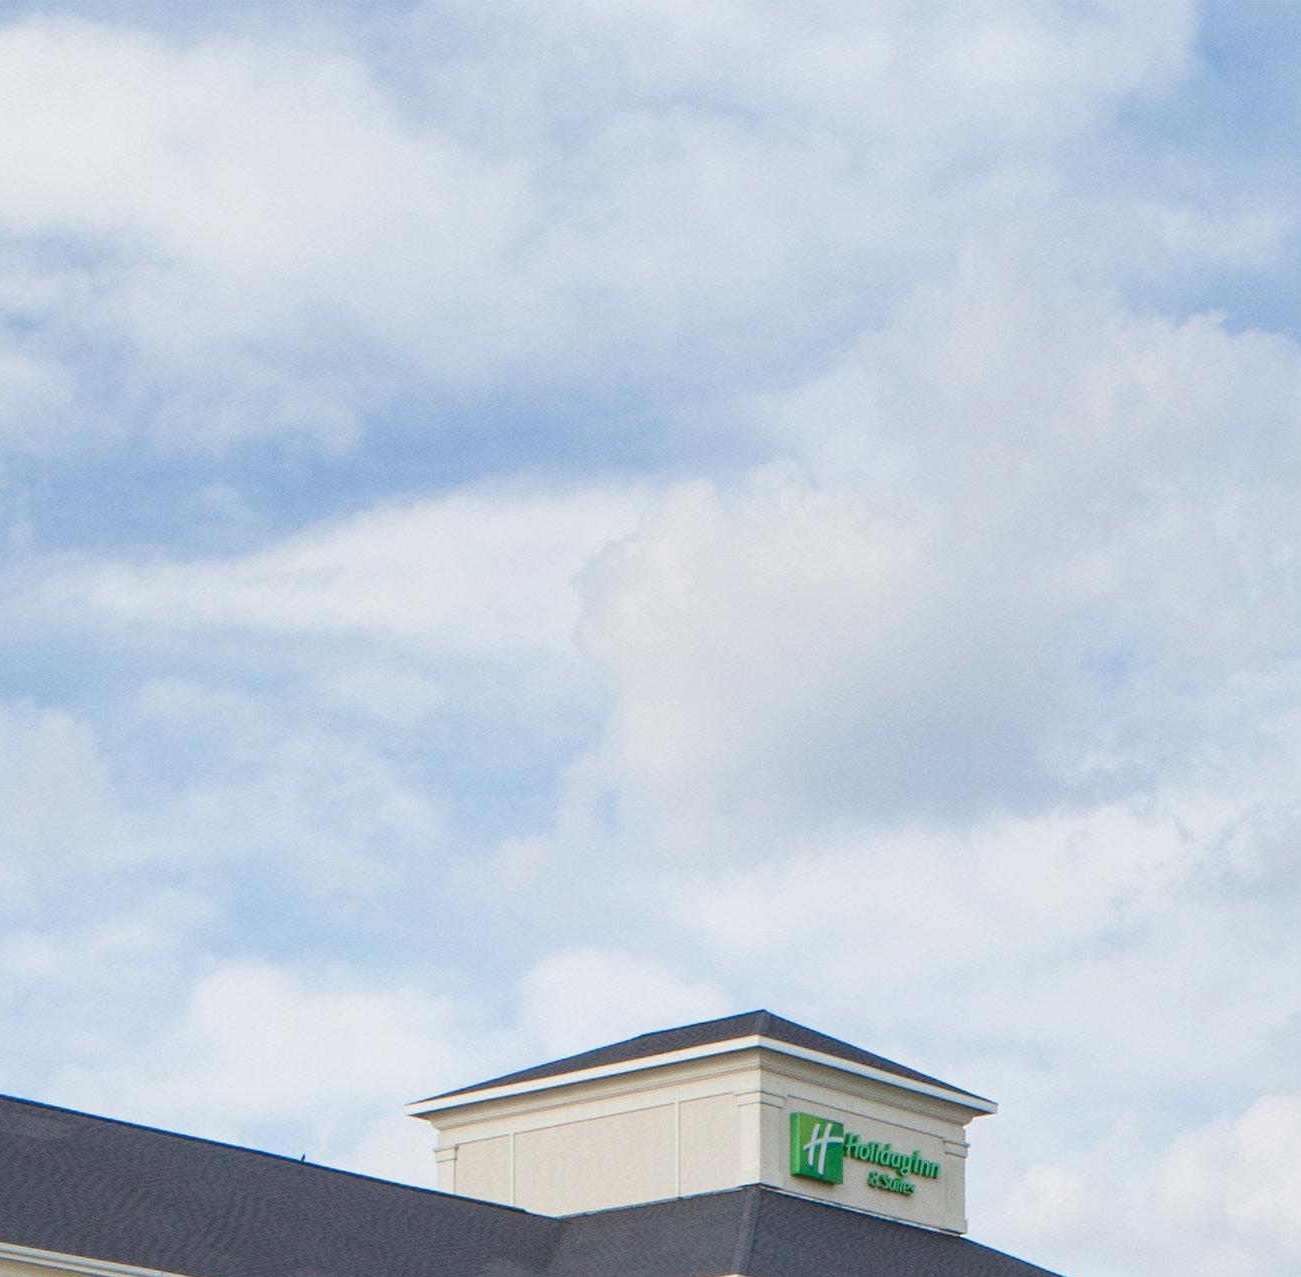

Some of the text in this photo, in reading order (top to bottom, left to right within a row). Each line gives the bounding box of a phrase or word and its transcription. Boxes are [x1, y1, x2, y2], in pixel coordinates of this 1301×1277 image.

[844, 1131, 941, 1179] Holiday Inn
[867, 1170, 916, 1197] & Suites
